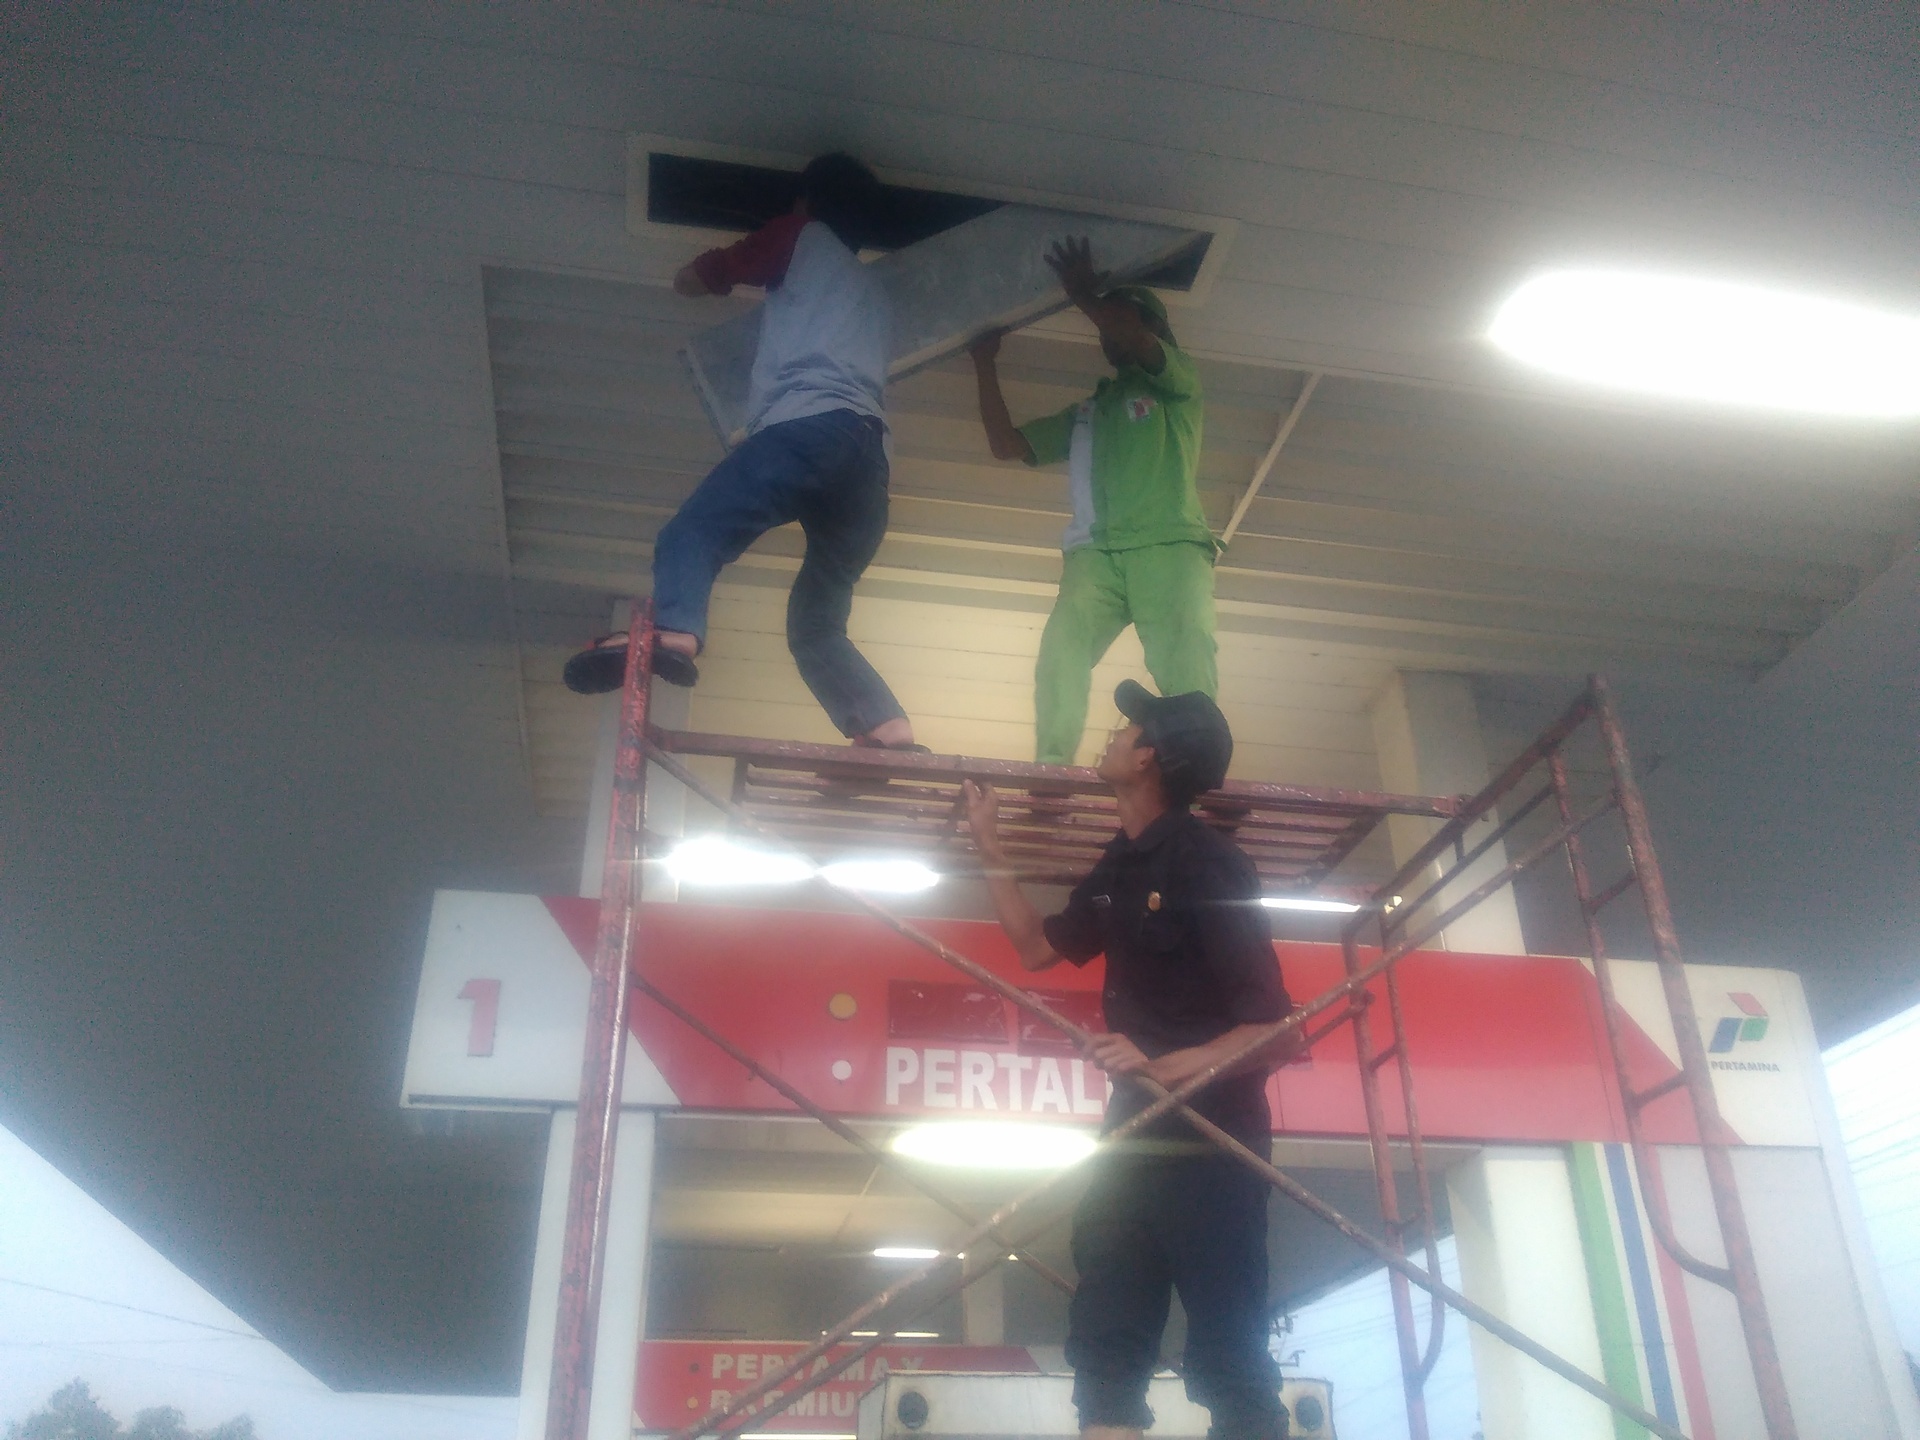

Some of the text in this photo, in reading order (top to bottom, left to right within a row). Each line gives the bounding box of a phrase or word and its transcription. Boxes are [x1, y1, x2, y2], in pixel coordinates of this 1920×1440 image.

[457, 979, 501, 1056] 1
[885, 1046, 1113, 1115] PERTAL
[1710, 1061, 1780, 1072] PERTAMINA
[712, 1353, 924, 1381] PERAMAX
